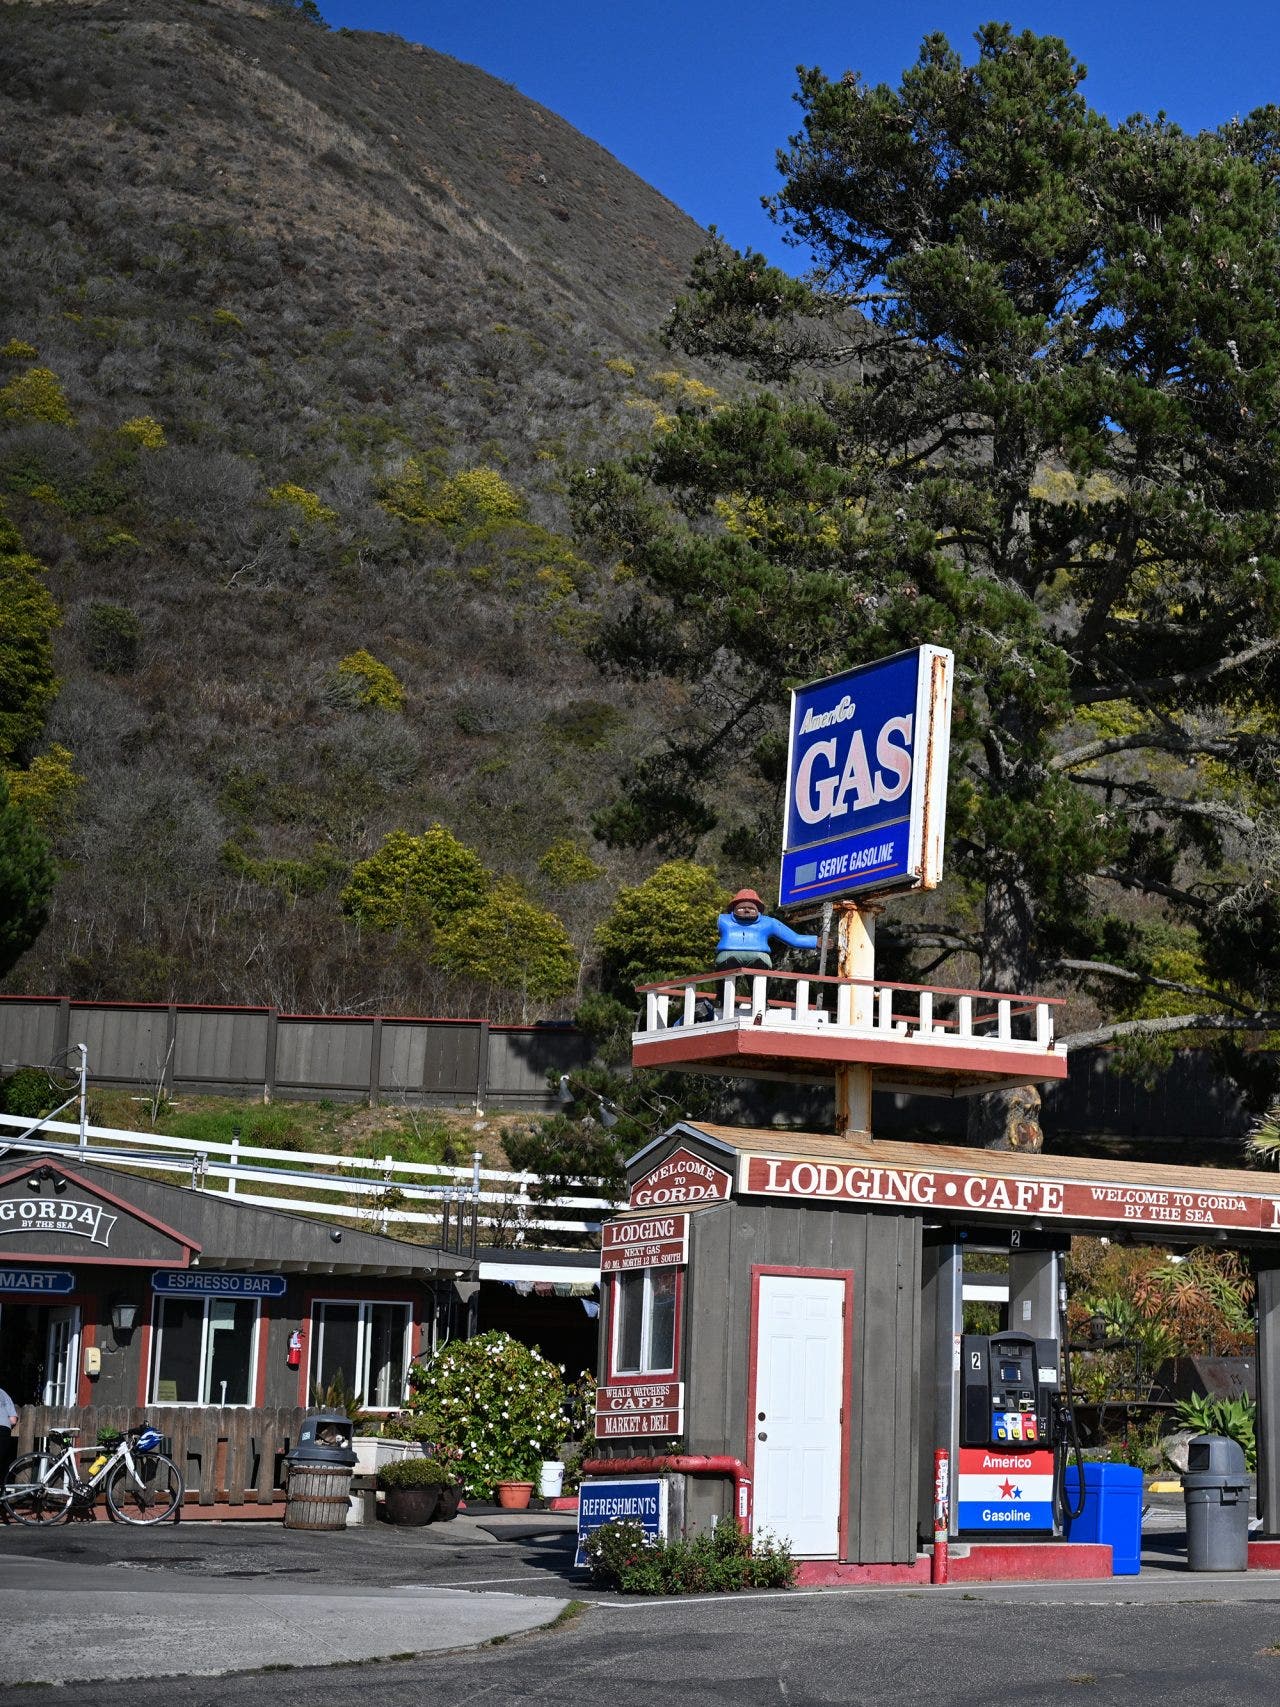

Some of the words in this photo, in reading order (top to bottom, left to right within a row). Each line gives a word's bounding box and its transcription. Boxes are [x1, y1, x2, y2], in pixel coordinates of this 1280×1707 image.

[795, 713, 914, 825] GAS
[818, 854, 849, 879] SERVE
[849, 841, 895, 871] GASOLINE
[647, 1161, 715, 1187] WELCOME
[674, 1176, 687, 1186] TO
[636, 1184, 720, 1206] GORDA
[765, 1160, 937, 1204] LODGING
[963, 1177, 1065, 1214] CAFE
[1091, 1187, 1169, 1206] WELCOME
[1174, 1194, 1194, 1207] TO
[1197, 1197, 1248, 1212] GORDA
[0, 1201, 95, 1225] GORDA
[1124, 1204, 1145, 1218] BY
[1149, 1206, 1181, 1221] THE
[1185, 1208, 1215, 1223] SEA
[21, 1219, 33, 1228] BY
[36, 1220, 55, 1229] THE
[56, 1221, 74, 1230] SEA
[611, 1219, 675, 1244] LODGING
[621, 1256, 642, 1268] NORTH
[642, 1256, 650, 1266] 12
[660, 1252, 681, 1263] SOUTH
[624, 1247, 645, 1258] NEXT
[646, 1244, 661, 1255] GAS
[0, 1273, 57, 1289] MART
[168, 1274, 240, 1290] ESPRESSO
[243, 1279, 270, 1292] BAR
[972, 1353, 980, 1369] 2
[606, 1388, 632, 1398] WHALE
[633, 1385, 670, 1397] WATCHERS
[610, 1395, 665, 1410] CAFE
[605, 1416, 640, 1434] MARKET
[642, 1416, 649, 1432] &
[650, 1414, 669, 1431] DELI
[982, 1455, 1032, 1468] Americo
[582, 1497, 657, 1516] REFRESHMENTS
[982, 1509, 1031, 1522] Gasoline
